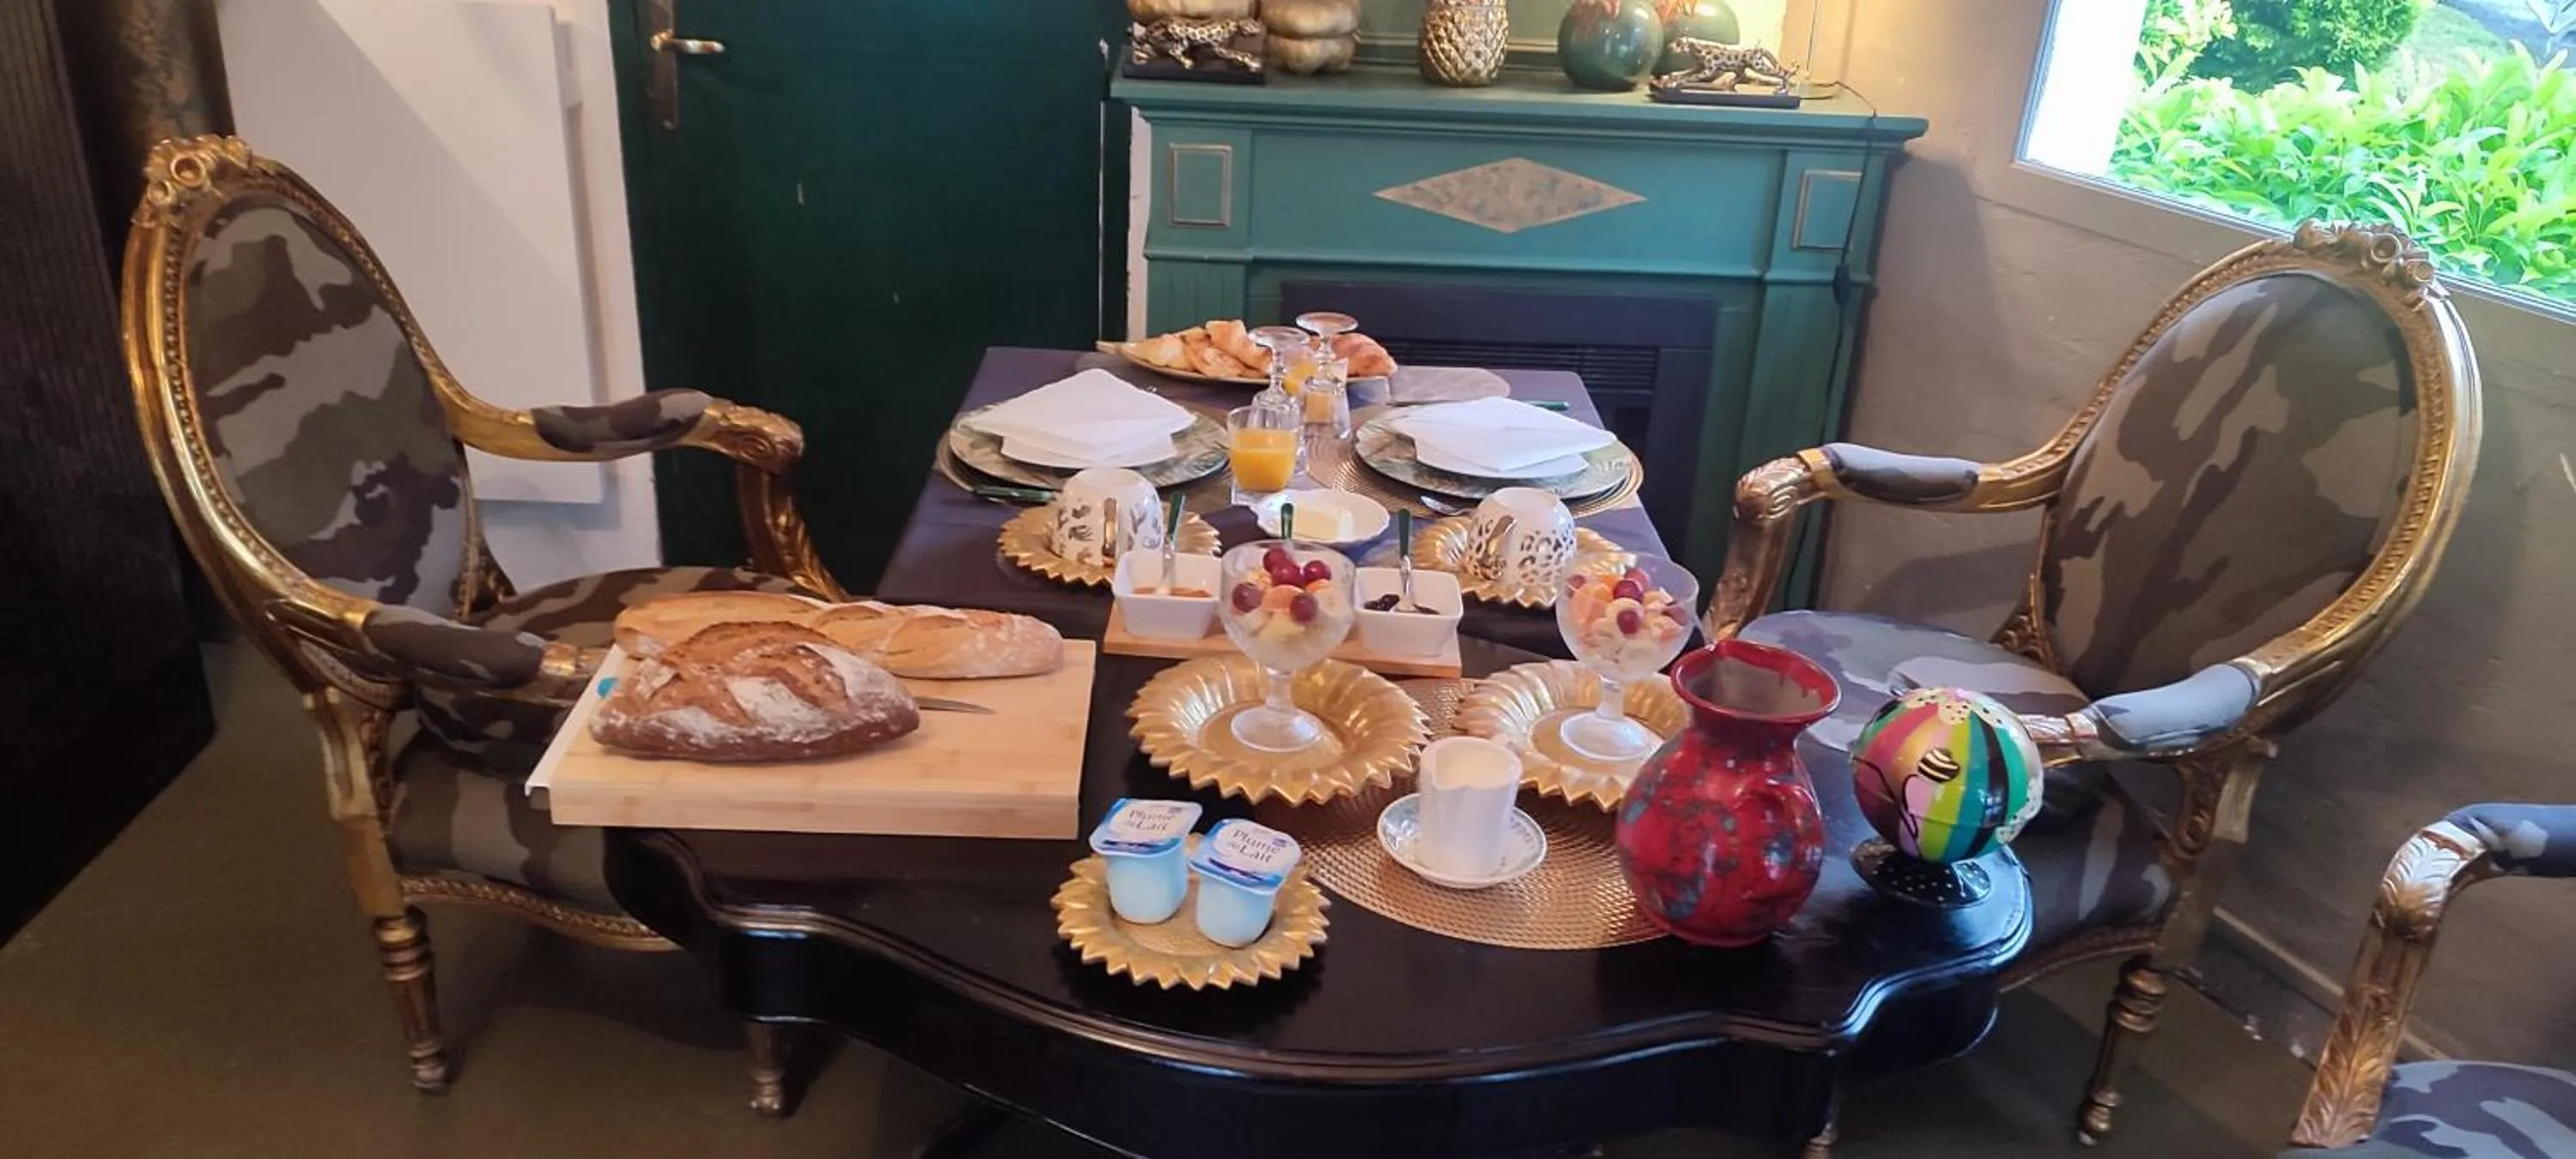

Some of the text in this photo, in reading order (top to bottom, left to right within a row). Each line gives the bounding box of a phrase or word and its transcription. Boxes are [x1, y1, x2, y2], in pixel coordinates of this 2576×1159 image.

[1136, 821, 1168, 831] Lait
[1233, 828, 1281, 853] Plume
[1239, 844, 1273, 863] Lait
